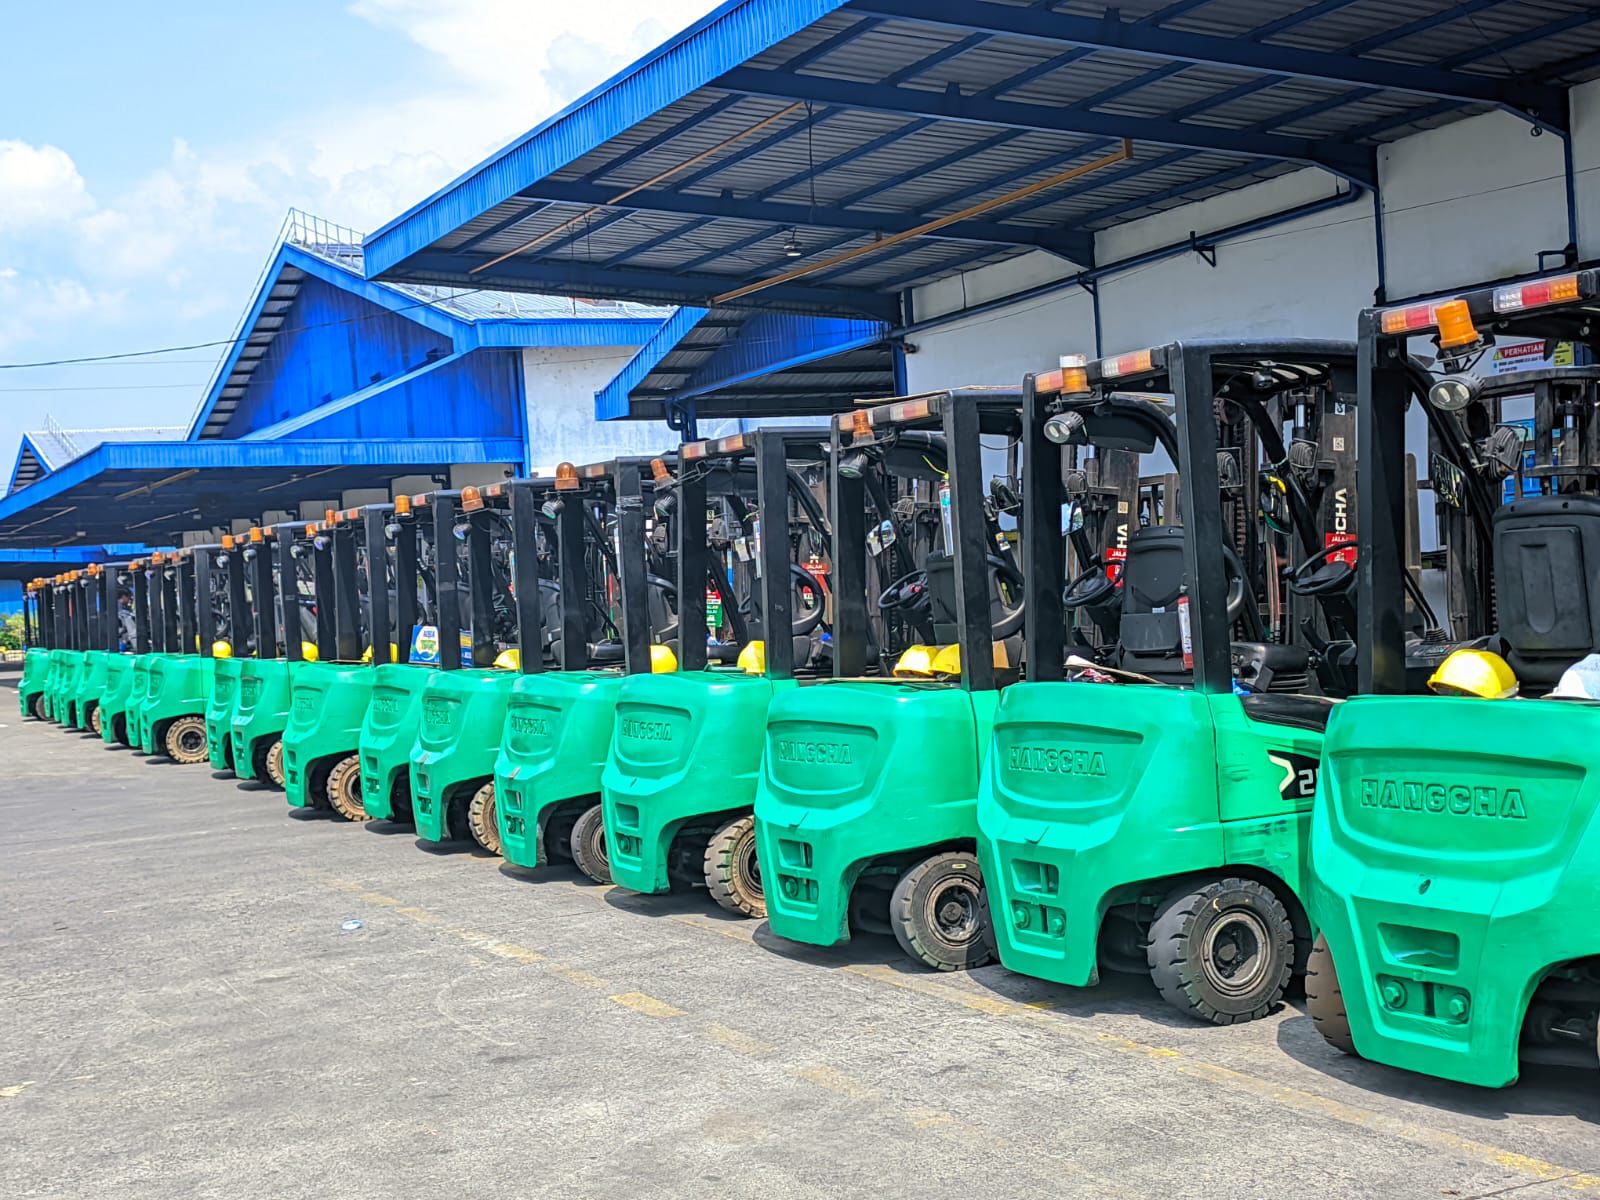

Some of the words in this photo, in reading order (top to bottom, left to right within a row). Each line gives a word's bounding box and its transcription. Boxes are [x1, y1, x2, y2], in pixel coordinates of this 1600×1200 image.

[1504, 343, 1545, 357] PERHATIAN
[1335, 488, 1347, 534] CHA
[1009, 746, 1107, 777] HANGCHA
[1298, 768, 1319, 796] 2
[1361, 778, 1528, 820] HANGCHA
